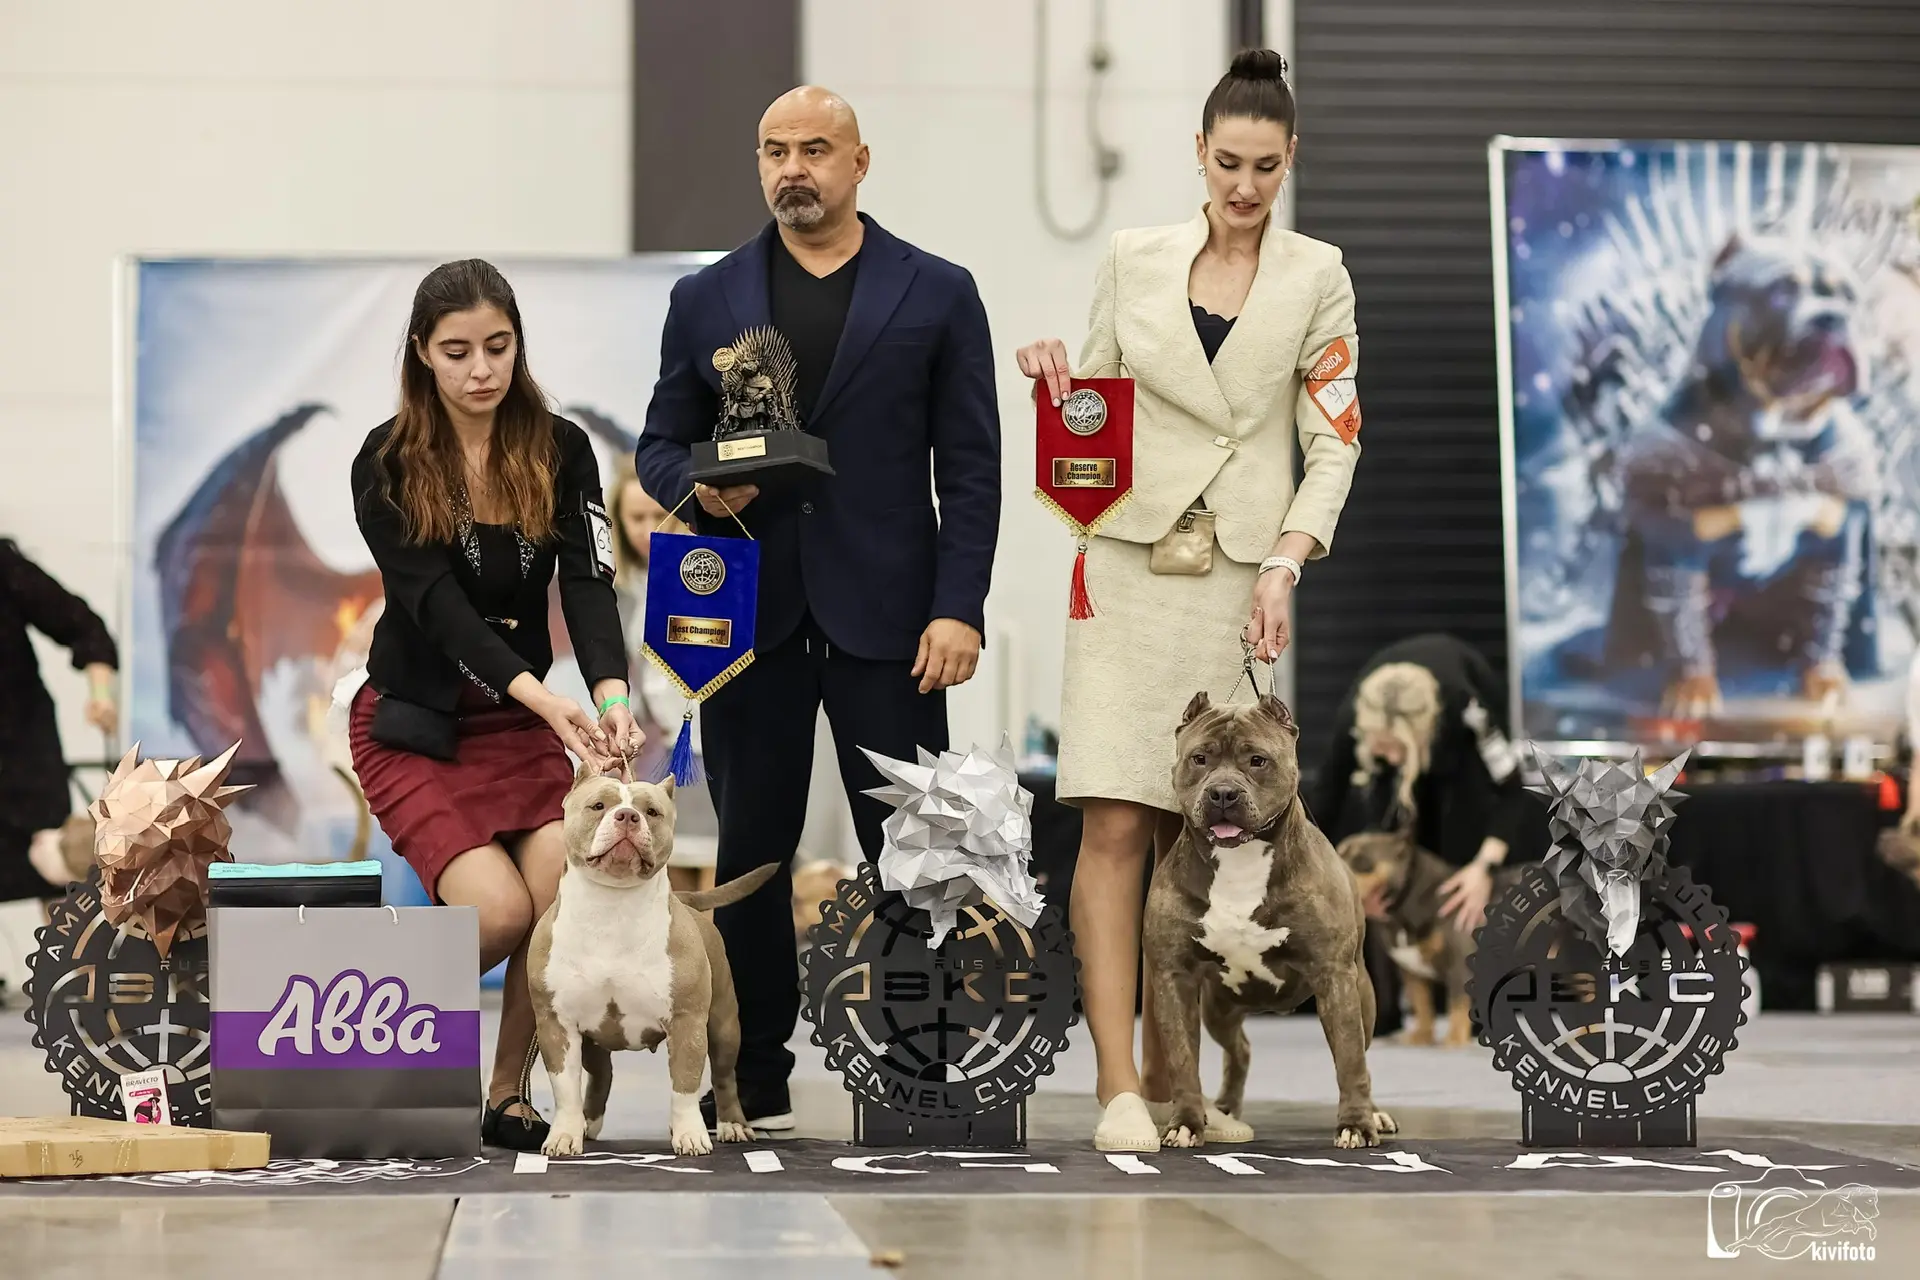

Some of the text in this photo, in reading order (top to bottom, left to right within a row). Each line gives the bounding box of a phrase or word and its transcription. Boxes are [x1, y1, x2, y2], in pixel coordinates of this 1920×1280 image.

[1066, 472, 1101, 481] Champion
[1070, 462, 1098, 472] Reserve
[672, 625, 726, 636] Best Champion
[46, 880, 104, 962] AME
[52, 1034, 124, 1103] KENN
[831, 1033, 1052, 1109] KENNEL CLUB
[1499, 1033, 1721, 1111] KENNEL CLUB
